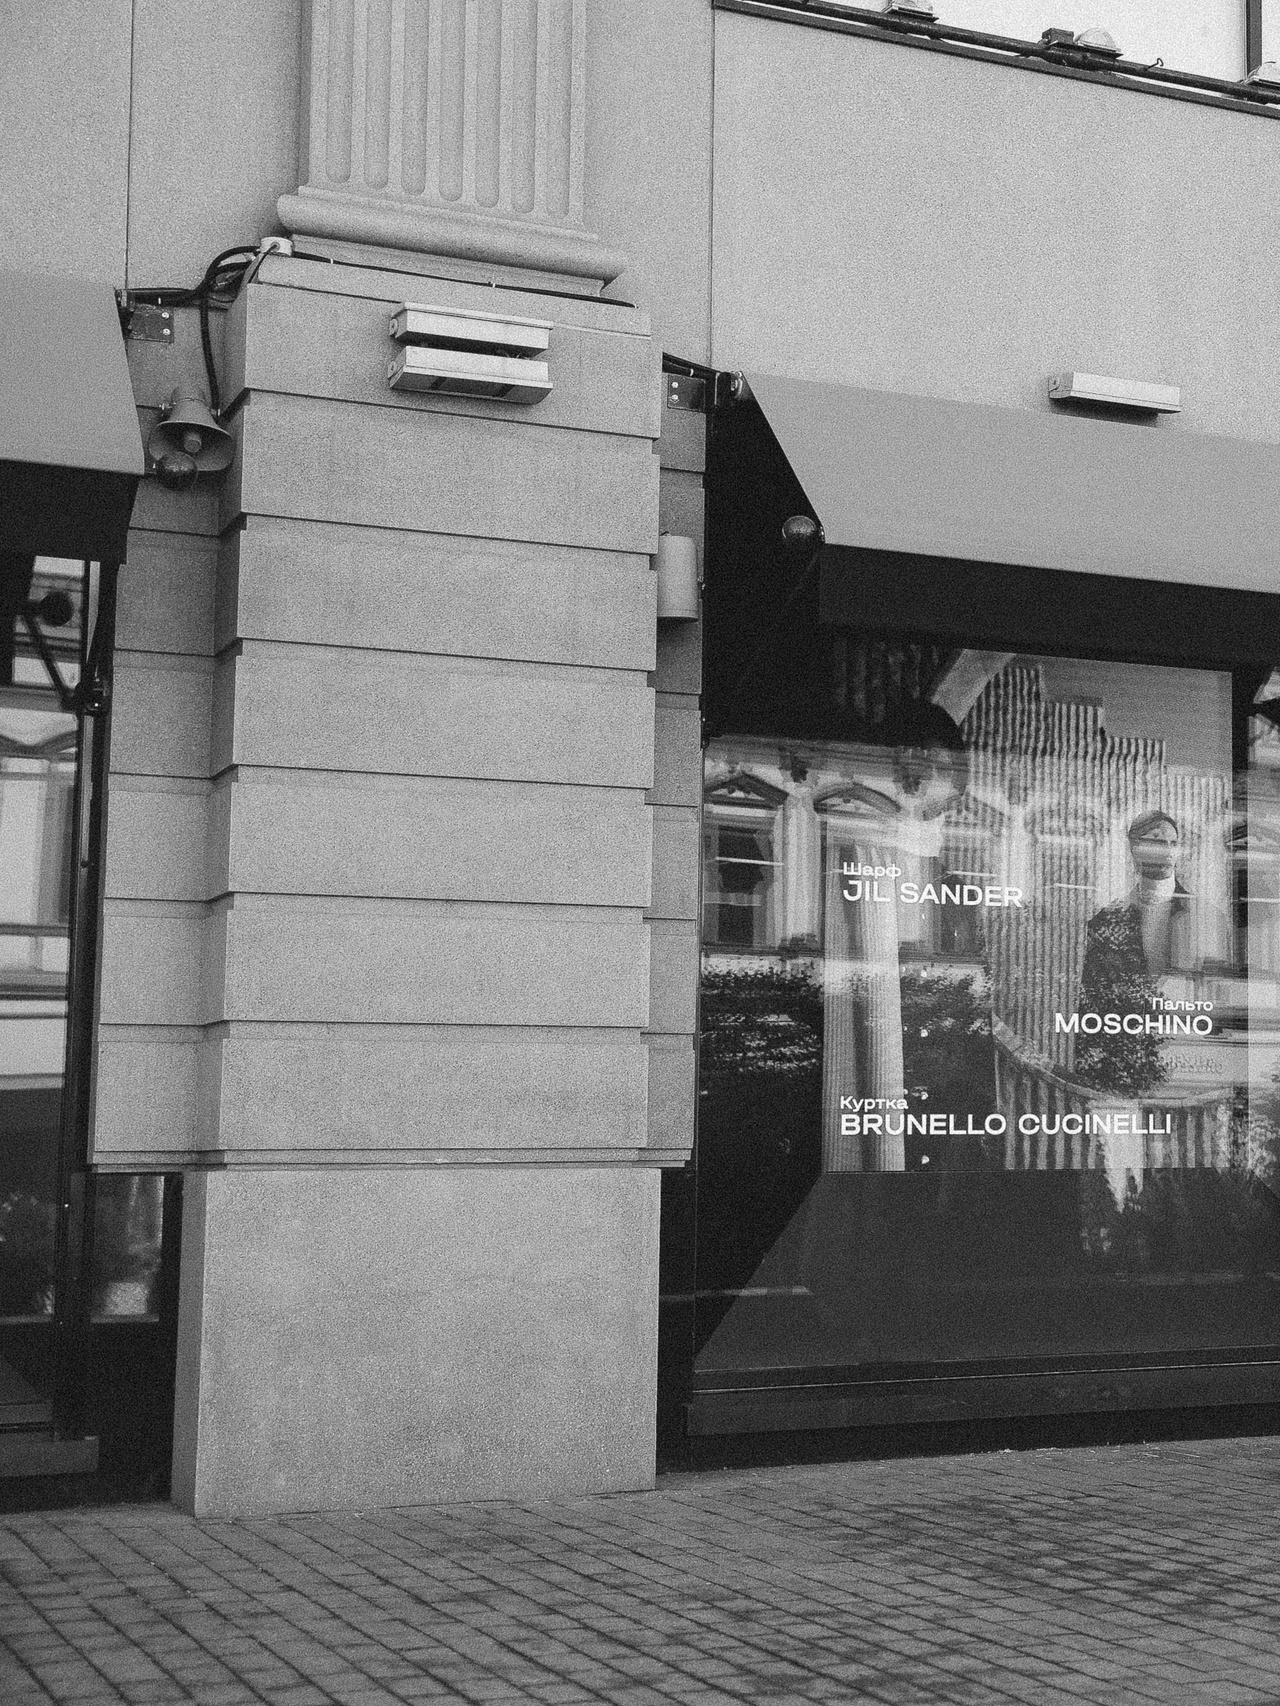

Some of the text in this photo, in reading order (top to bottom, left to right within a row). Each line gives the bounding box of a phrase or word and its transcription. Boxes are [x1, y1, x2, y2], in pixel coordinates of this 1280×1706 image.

[843, 861, 902, 879] Шарф
[843, 880, 1023, 908] JIL SANDER
[1152, 997, 1213, 1011] Пальто
[1055, 1012, 1213, 1036] MOSCHINO
[840, 1095, 908, 1111] Куртка
[840, 1113, 1171, 1136] BRUNELLO CUCINELLI
